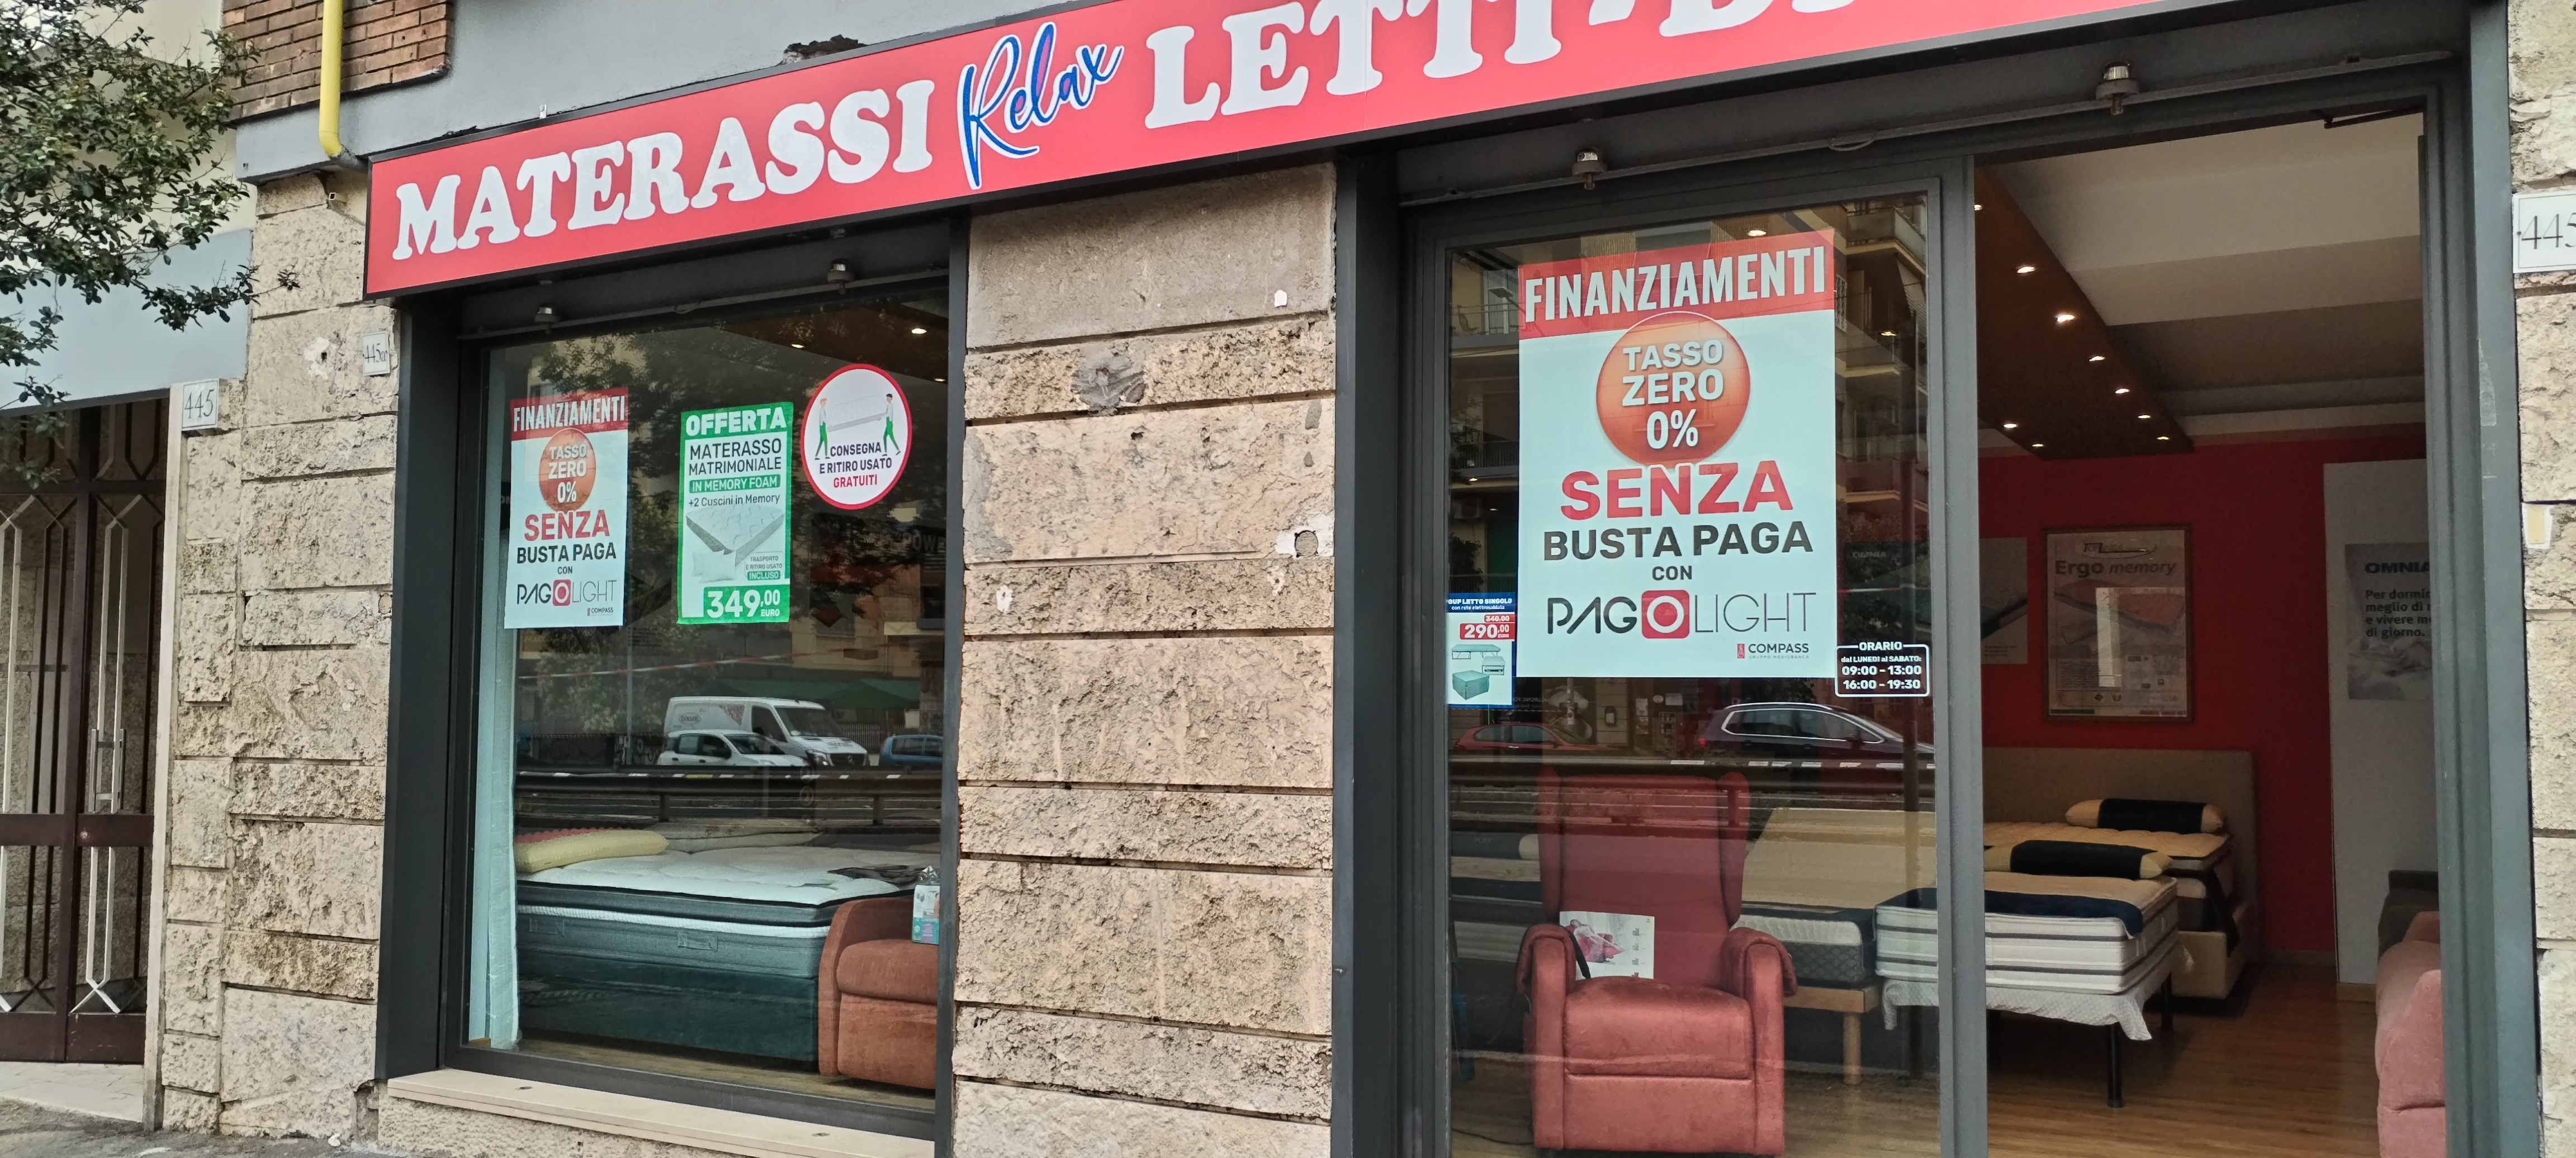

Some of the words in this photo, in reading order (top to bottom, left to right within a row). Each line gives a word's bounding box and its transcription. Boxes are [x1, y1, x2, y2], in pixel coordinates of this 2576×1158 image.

[392, 80, 935, 260] MATERASSI
[958, 21, 1124, 190] Relax
[1145, 0, 1561, 129] LETTI
[1524, 246, 1825, 322] FINANZIAMENTI
[365, 343, 386, 364] 445a
[1623, 339, 1722, 371] TASSO
[1622, 369, 1723, 407] ZERO
[184, 388, 215, 419] 445
[513, 395, 625, 432] FINANZIAMENTI
[686, 407, 787, 436] OFFERTA
[1646, 408, 1698, 449] 0%
[550, 444, 587, 459] TASSO
[690, 438, 782, 460] MATERASSO
[830, 442, 882, 457] CONSEGNA
[548, 459, 587, 480] ZERO
[689, 457, 782, 476] MATRIMONIALE
[820, 463, 825, 474] E
[827, 461, 858, 473] RITIRO
[860, 457, 892, 471] USATO
[692, 481, 702, 492] IN
[704, 478, 747, 491] MEMORY
[749, 476, 777, 488] FOAM
[834, 474, 878, 488] GRATUITI
[1560, 460, 1793, 520] SENZA
[557, 481, 577, 503] 0%
[689, 497, 699, 507] +2
[702, 495, 733, 506] Cuscini
[735, 495, 743, 504] in
[745, 494, 780, 504] Memory
[524, 510, 610, 541] SENZA
[1544, 526, 1682, 561] BUSTA
[1693, 521, 1813, 556] PAGA
[517, 545, 569, 564] BUSTA
[573, 542, 616, 561] PAGA
[557, 566, 572, 575] CON
[1652, 565, 1692, 581] CON
[2055, 560, 2105, 578] Ergo
[2109, 562, 2176, 576] memory
[517, 580, 617, 606] PAGOLIGHT
[2365, 590, 2385, 599] Per
[1547, 590, 1816, 639] PAGOLIGHT
[2366, 601, 2408, 614] meglio
[2412, 601, 2423, 611] di
[2376, 615, 2413, 624] vivere
[2366, 627, 2376, 637] di
[2381, 627, 2425, 639] giorno.
[1748, 643, 1809, 653] COMPASS
[1859, 642, 1902, 651] ORARIO
[1842, 666, 1877, 675] 09:00
[1887, 666, 1921, 675] 13:00
[1843, 680, 1876, 689] 16:00
[1887, 680, 1921, 689] 19:30
